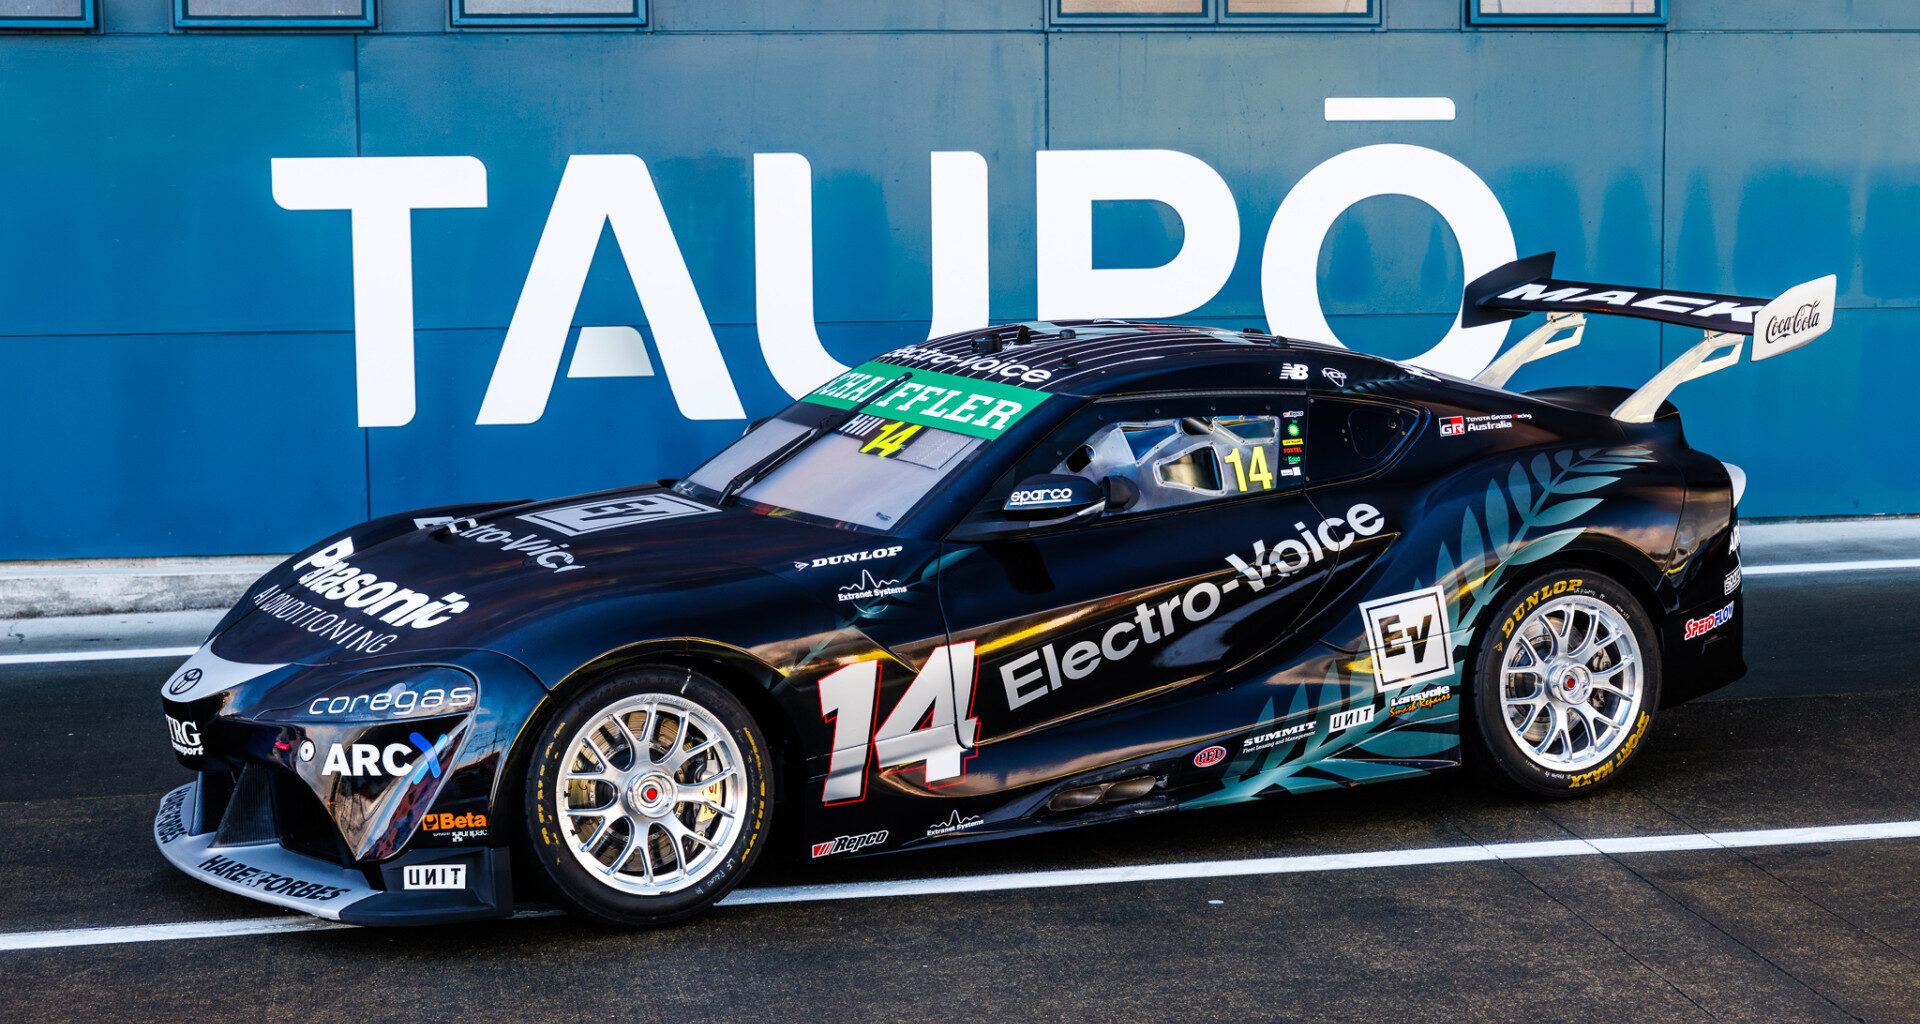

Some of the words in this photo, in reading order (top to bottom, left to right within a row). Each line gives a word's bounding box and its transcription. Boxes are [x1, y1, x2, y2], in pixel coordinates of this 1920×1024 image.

[271, 97, 1518, 427] TAUPŌ
[1498, 283, 1765, 324] MACK
[860, 421, 923, 457] 14
[1467, 420, 1512, 432] Australia
[1224, 446, 1273, 492] 14
[1010, 486, 1073, 506] sparco
[811, 546, 903, 568] DUNLOP
[838, 591, 873, 602] Extranet
[874, 586, 908, 597] Systems
[1000, 503, 1384, 711] Electro-Voice
[1502, 579, 1583, 639] DUNLOP
[309, 687, 473, 715] coregas
[165, 714, 201, 746] TRG
[818, 639, 981, 807] 14
[1243, 721, 1317, 747] SUMMIT
[1198, 749, 1223, 763] PFD
[1568, 760, 1614, 788] MAXX
[440, 812, 487, 829] Beta
[832, 830, 889, 853] Repco
